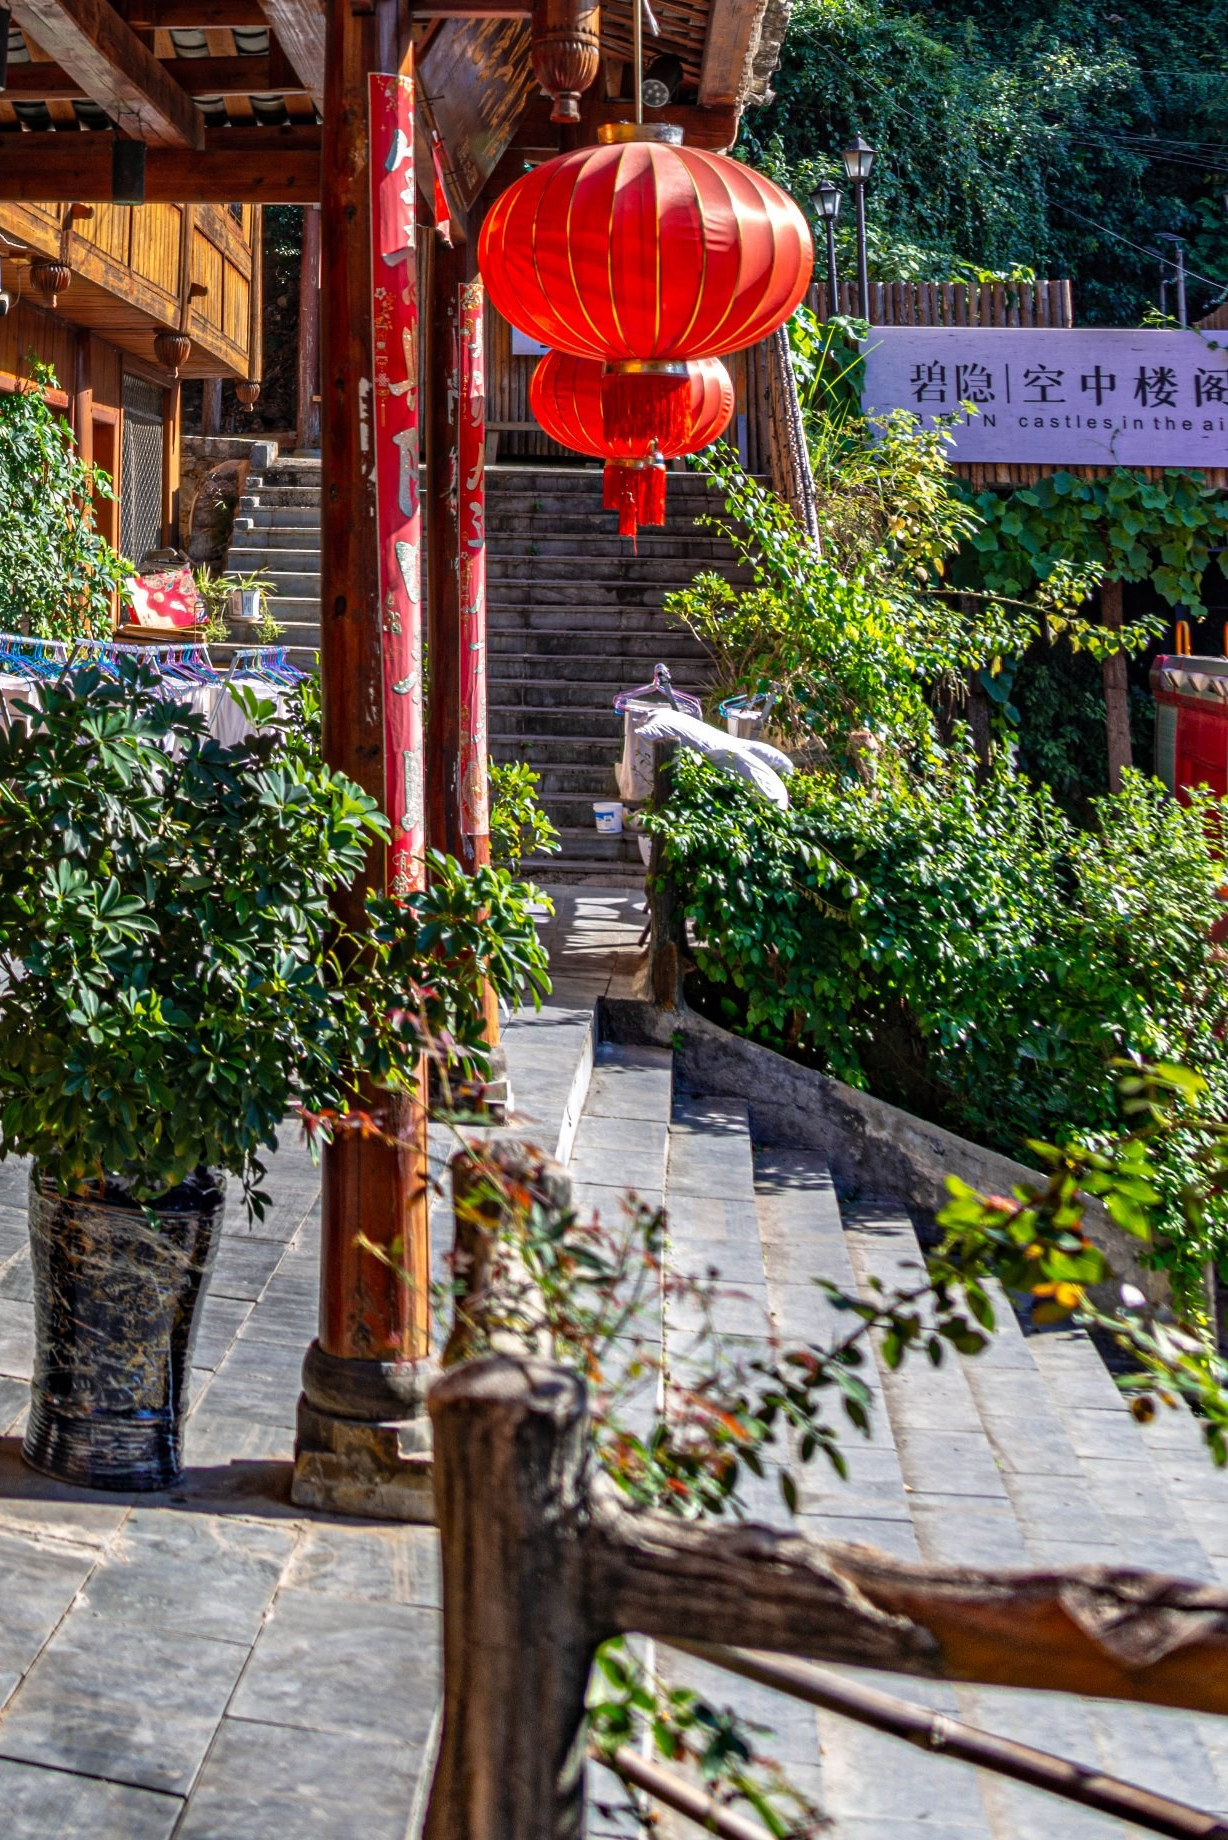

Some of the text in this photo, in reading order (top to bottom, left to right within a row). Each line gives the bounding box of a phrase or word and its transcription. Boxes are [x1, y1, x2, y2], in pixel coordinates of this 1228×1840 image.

[1018, 414, 1113, 429] castles
[1122, 415, 1144, 430] in
[1153, 416, 1193, 431] the
